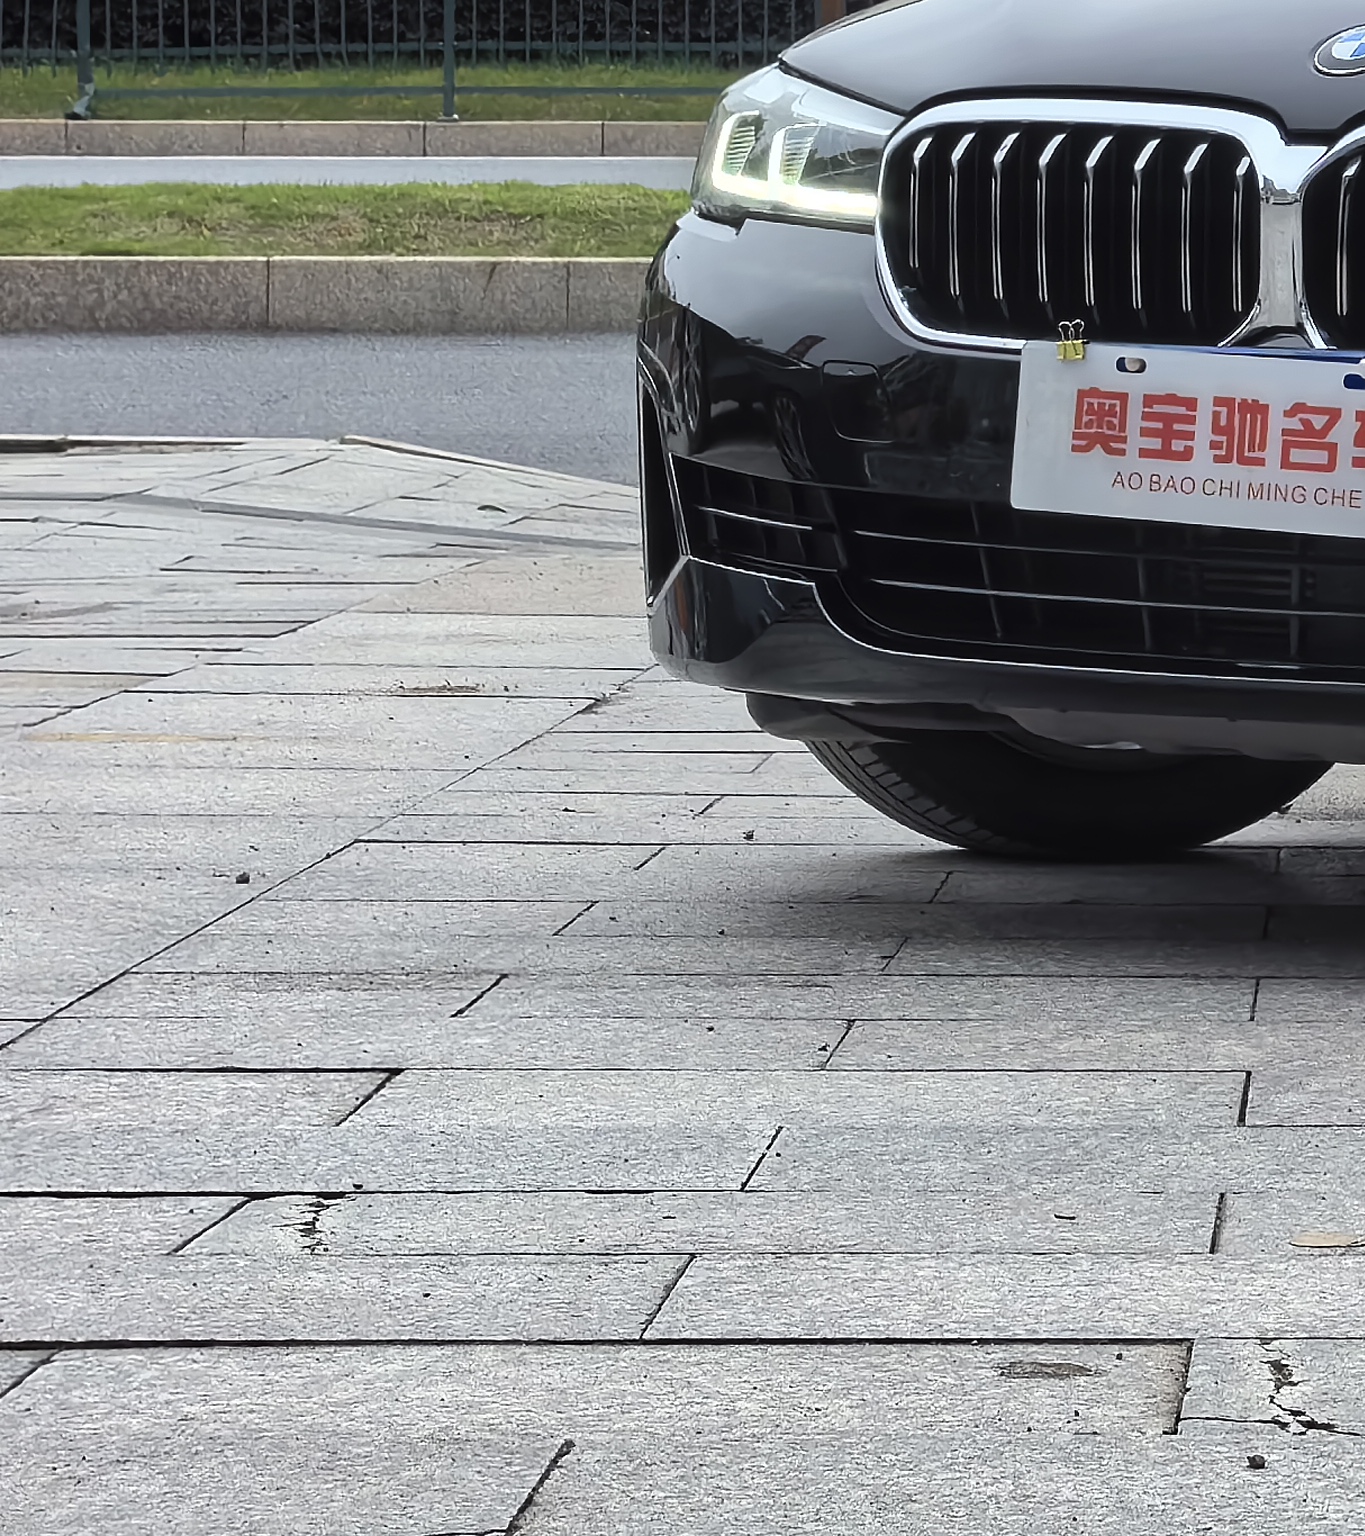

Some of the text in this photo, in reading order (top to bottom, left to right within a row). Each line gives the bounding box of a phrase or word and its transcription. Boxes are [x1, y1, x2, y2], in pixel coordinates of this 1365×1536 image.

[1111, 471, 1363, 509] AO BAO CHI MING CHE
